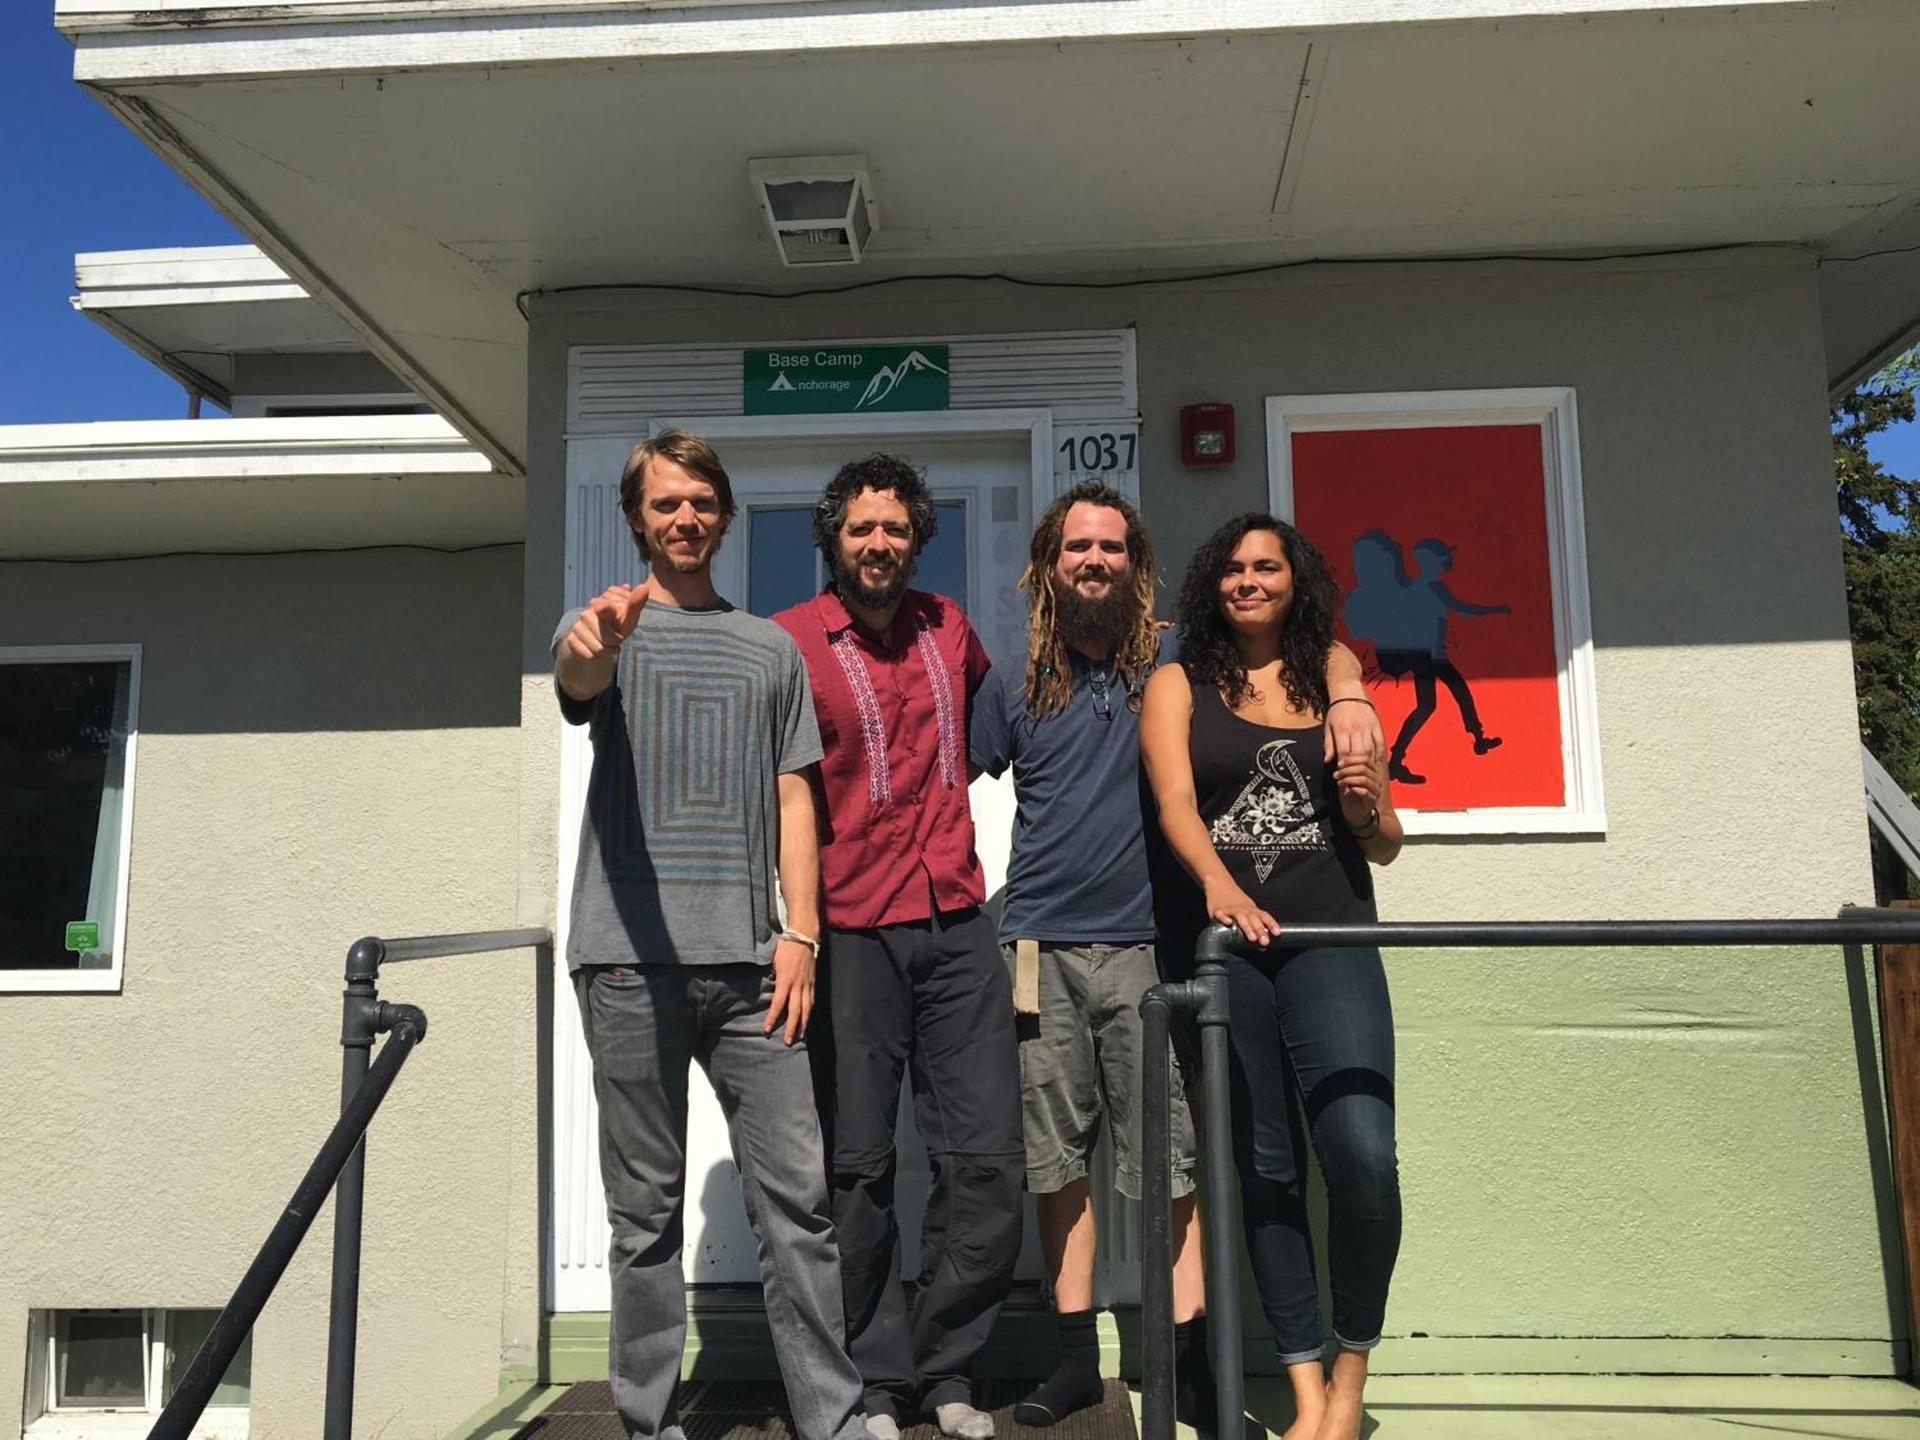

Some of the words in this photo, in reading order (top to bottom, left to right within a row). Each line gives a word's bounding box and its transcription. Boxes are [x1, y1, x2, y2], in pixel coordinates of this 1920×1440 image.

[768, 352, 809, 367] Base
[814, 351, 863, 368] Camp
[1059, 432, 1137, 471] 1037
